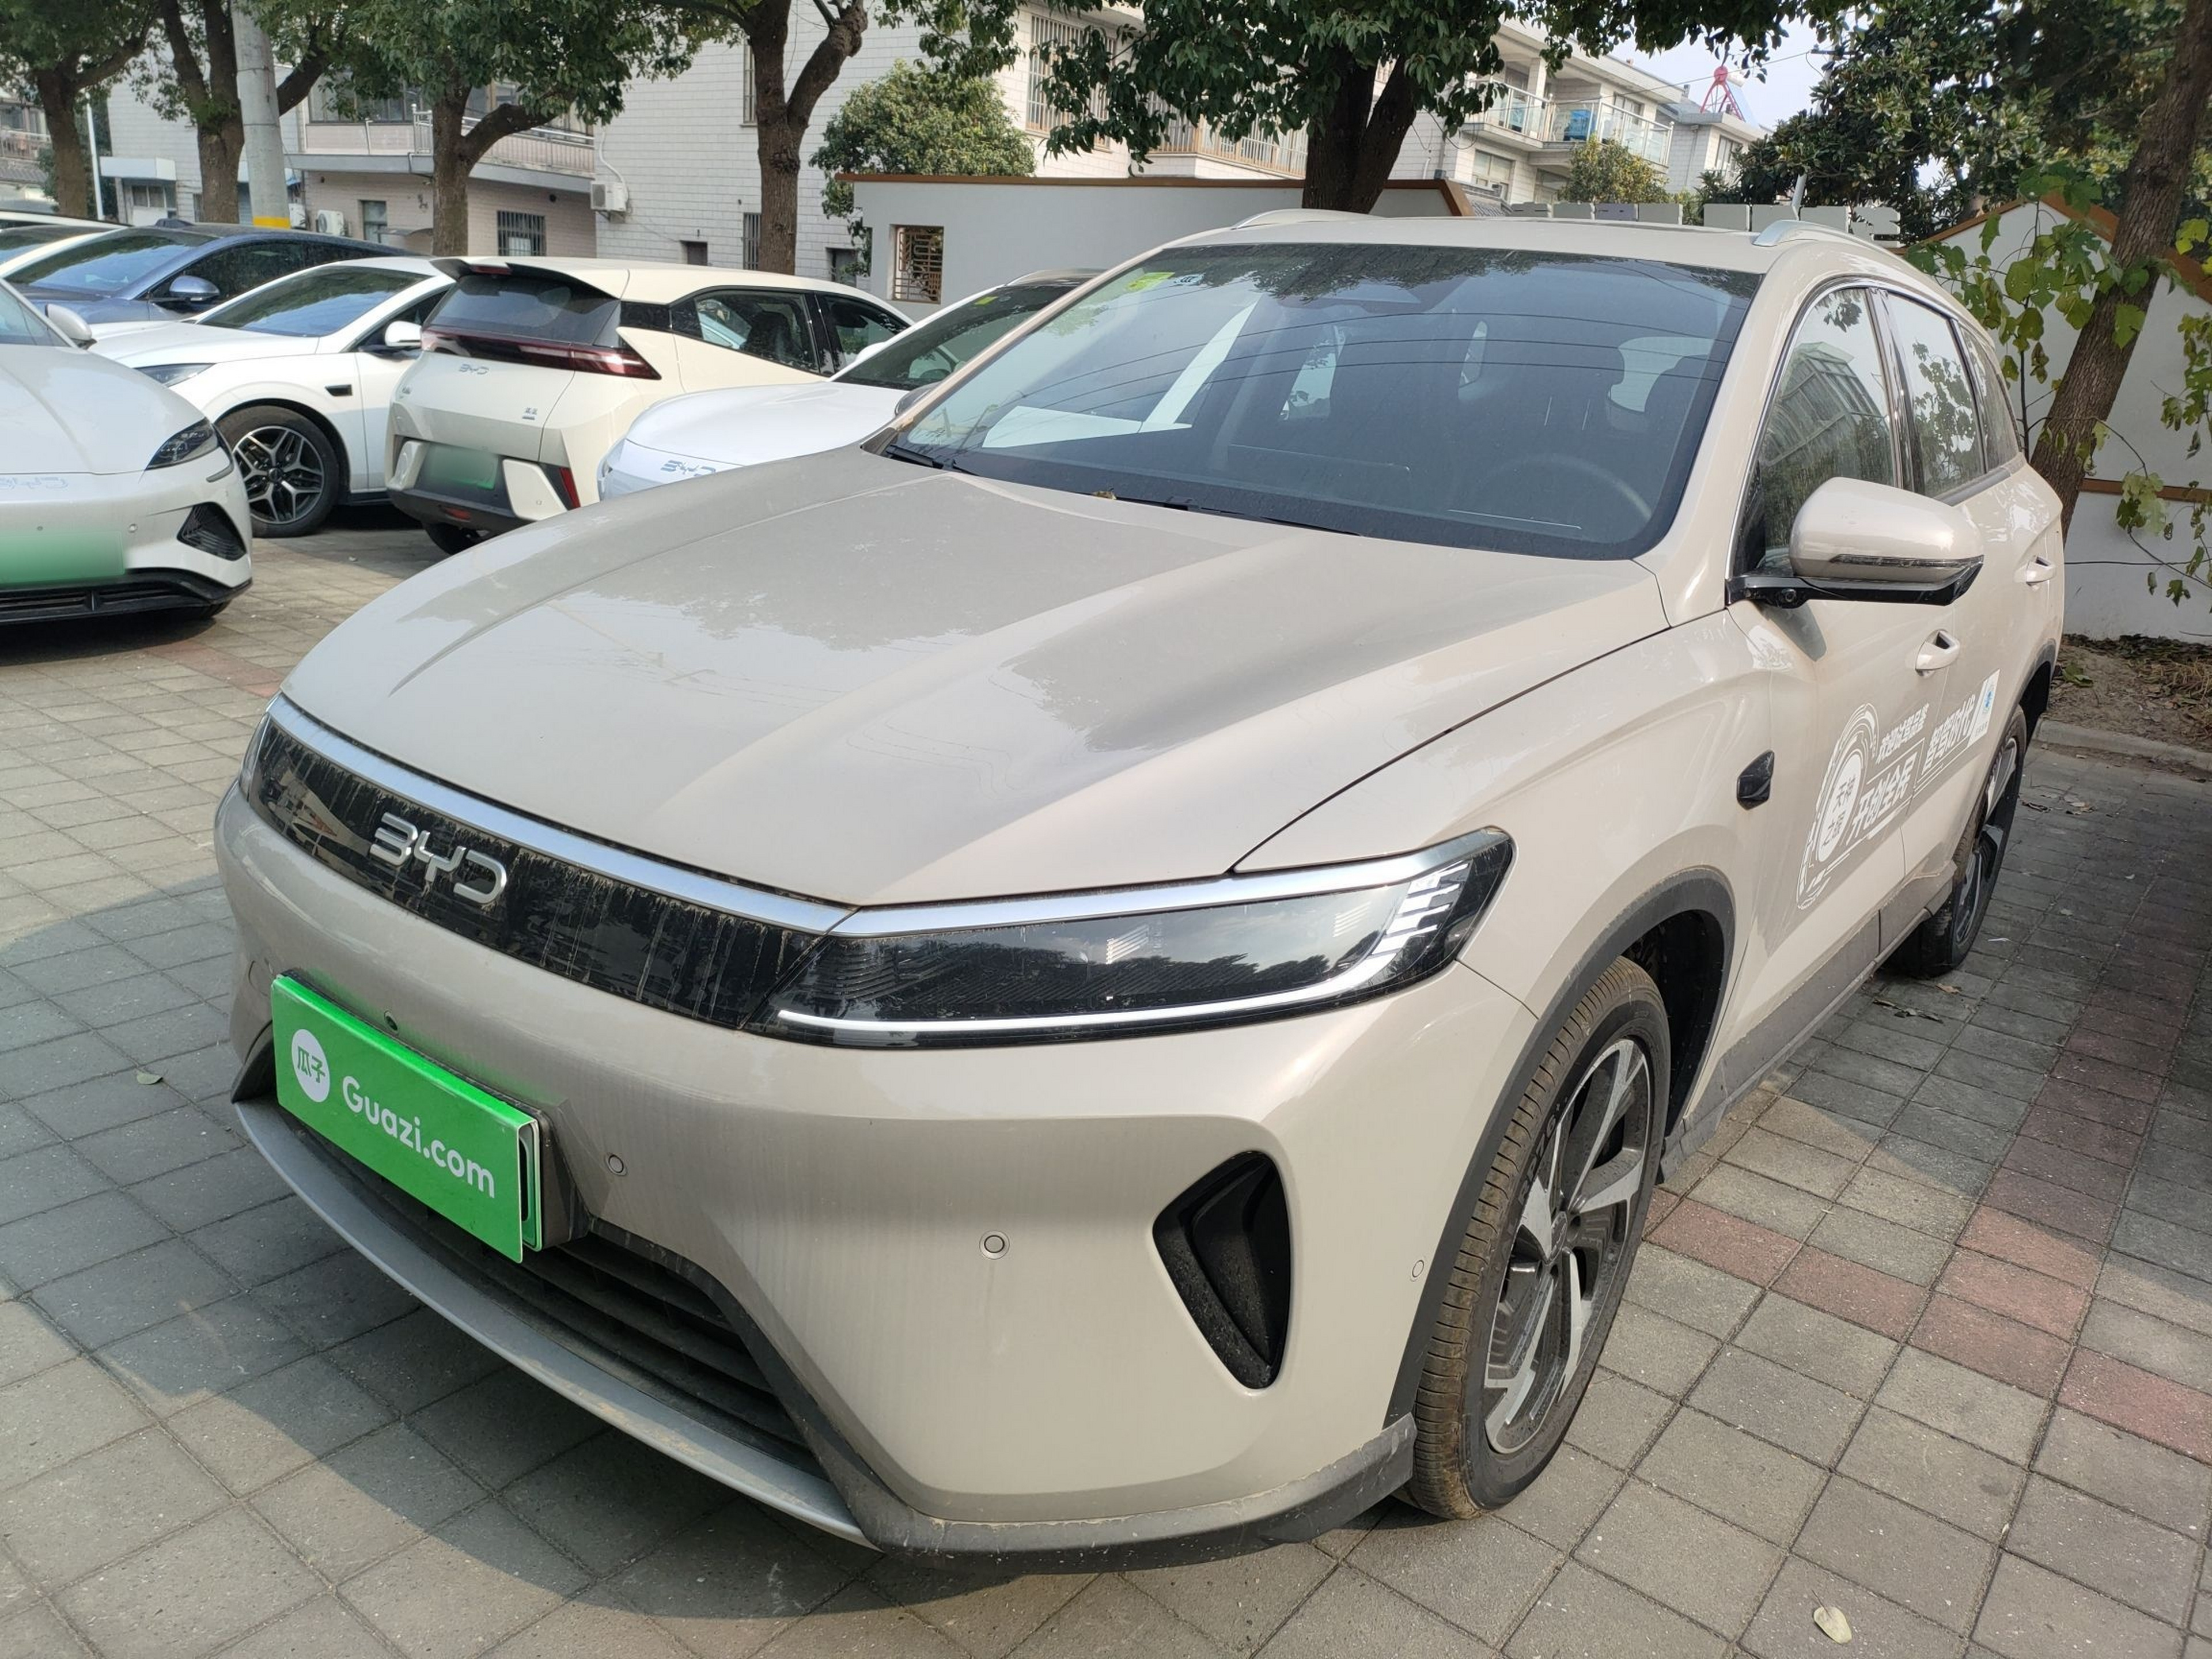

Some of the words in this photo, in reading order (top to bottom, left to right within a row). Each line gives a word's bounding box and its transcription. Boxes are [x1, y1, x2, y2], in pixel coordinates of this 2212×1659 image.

[459, 363, 490, 375] BYD
[1846, 752, 1917, 846] 开创全民
[1922, 694, 1976, 775] 智驾时代
[370, 812, 507, 905] BYD
[297, 1046, 326, 1084] 瓜子
[342, 1075, 495, 1199] Guazi.com
